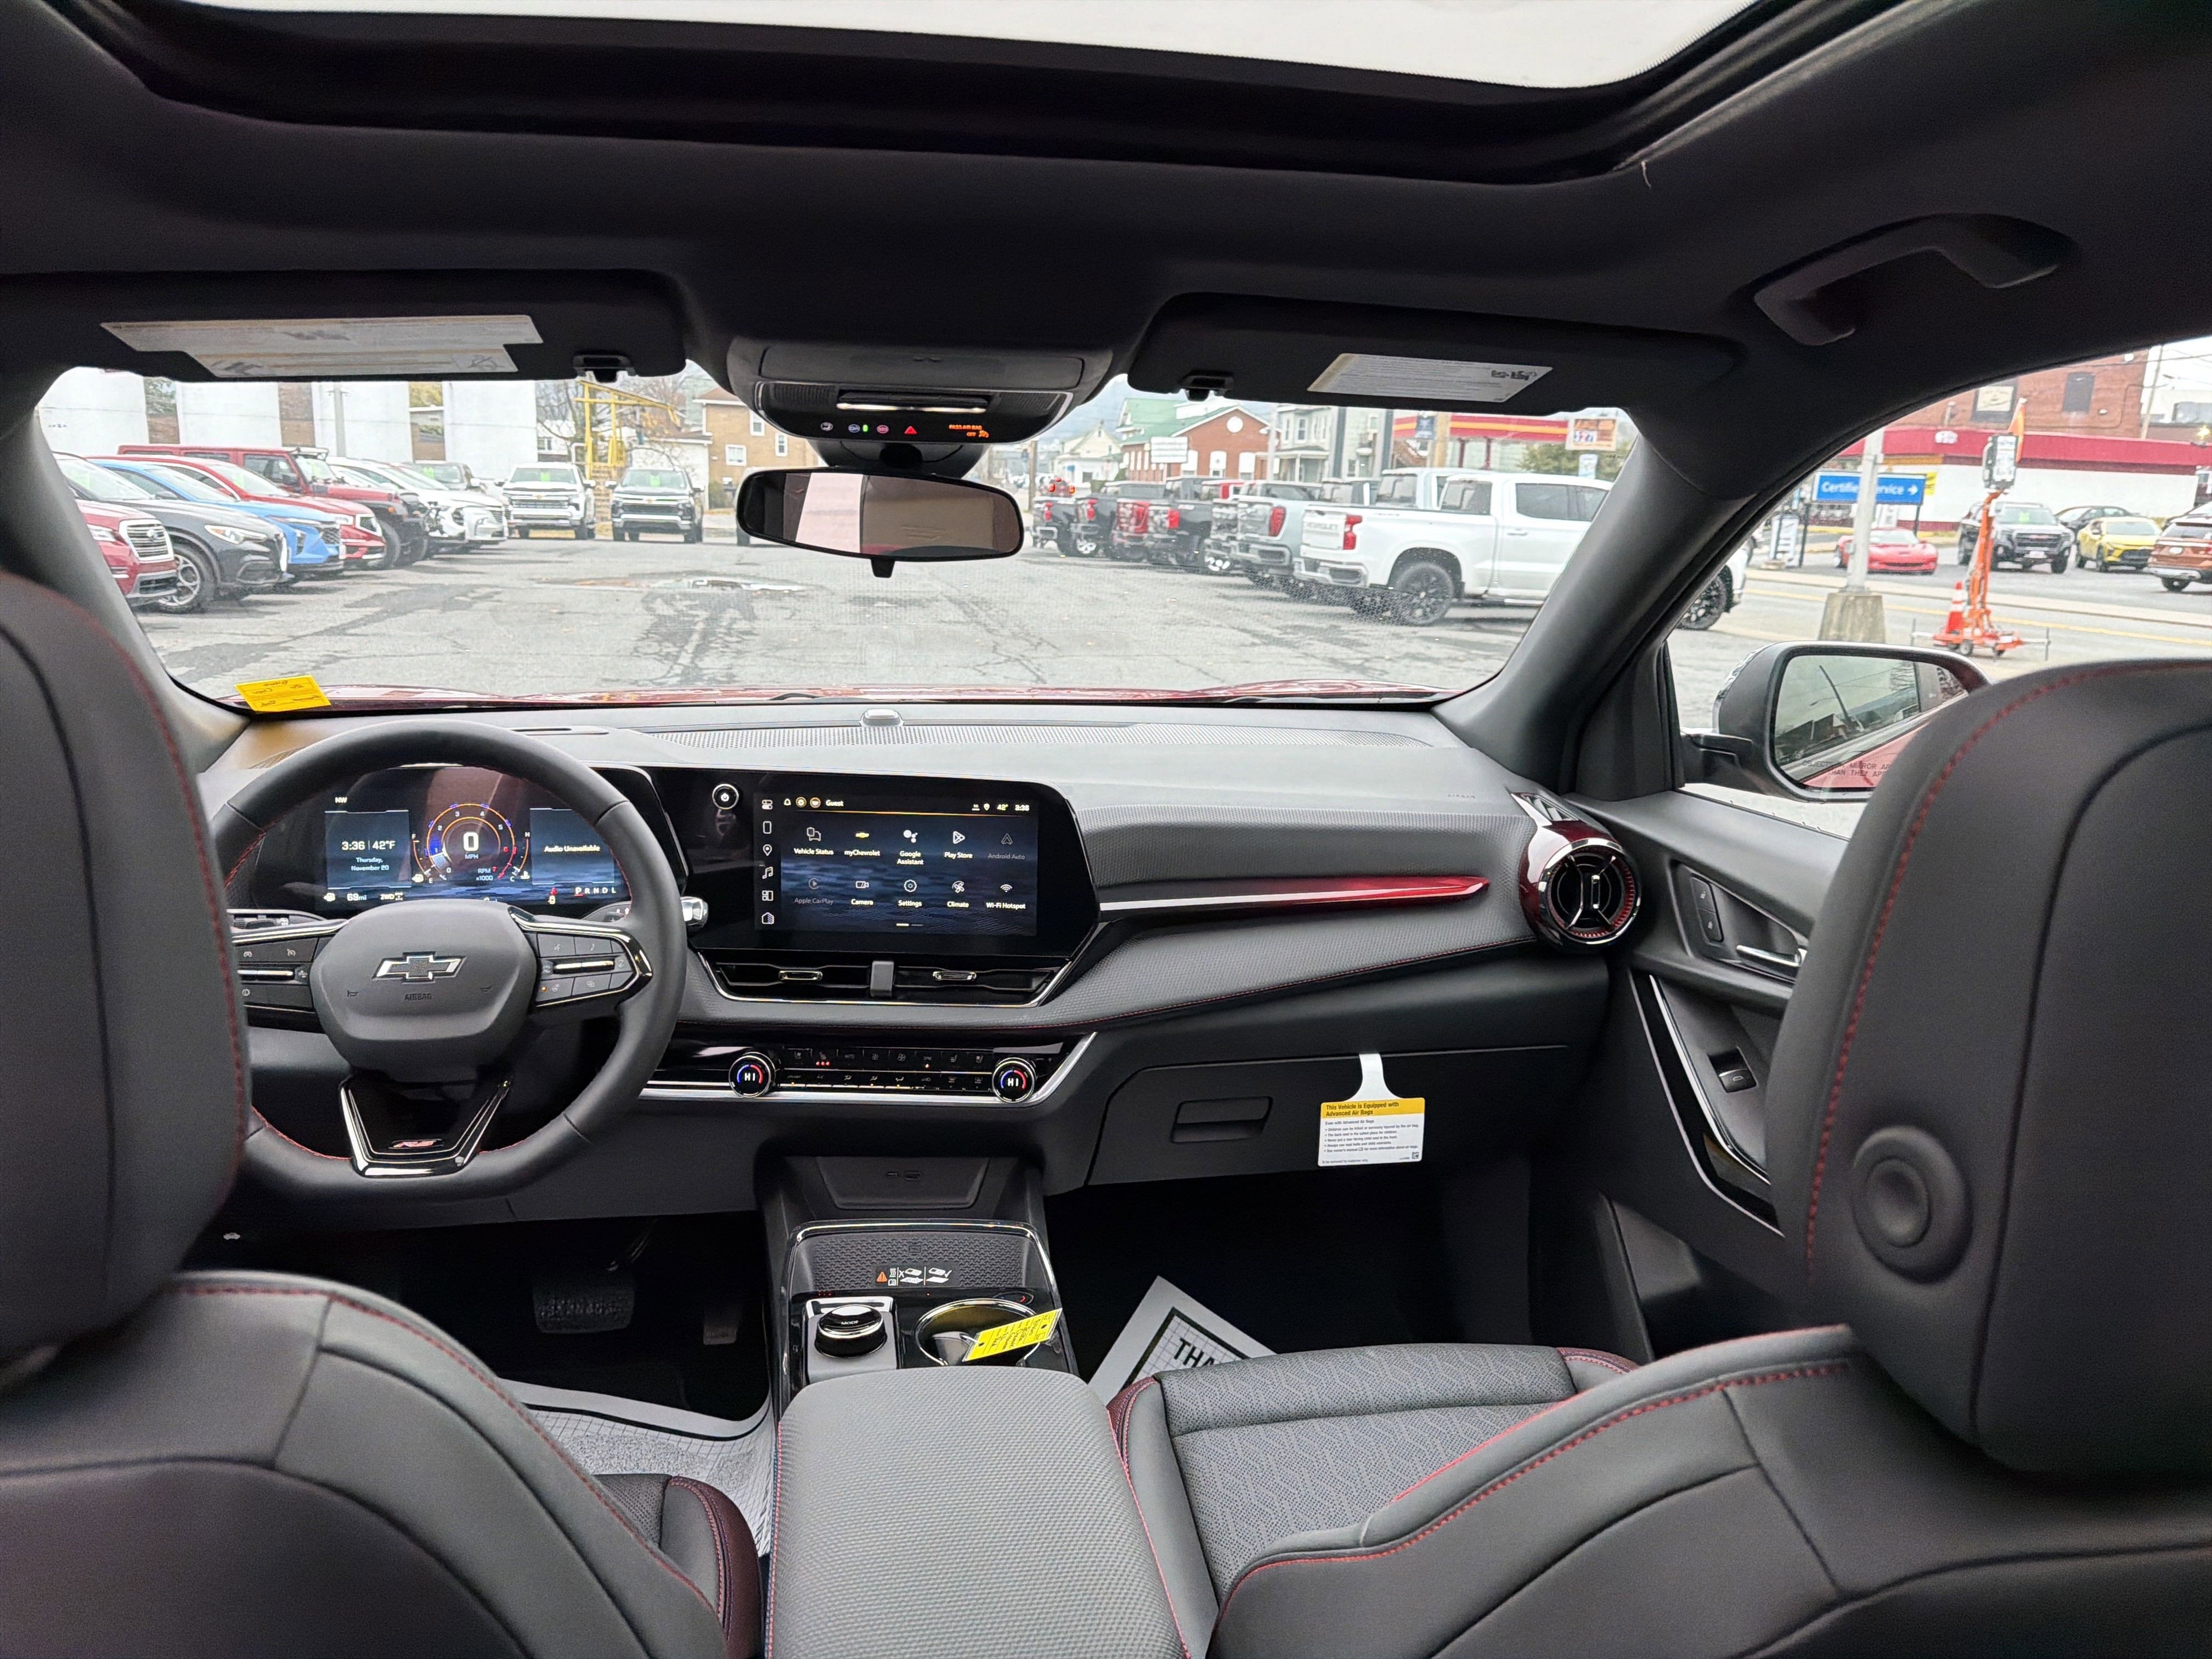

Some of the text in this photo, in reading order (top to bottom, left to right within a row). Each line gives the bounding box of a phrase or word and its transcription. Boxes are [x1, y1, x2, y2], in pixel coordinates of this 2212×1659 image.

[1821, 481, 1905, 495] Certifie ervice
[342, 840, 396, 850] 3:36 42°F
[463, 832, 478, 851] 0
[944, 851, 956, 860] Play
